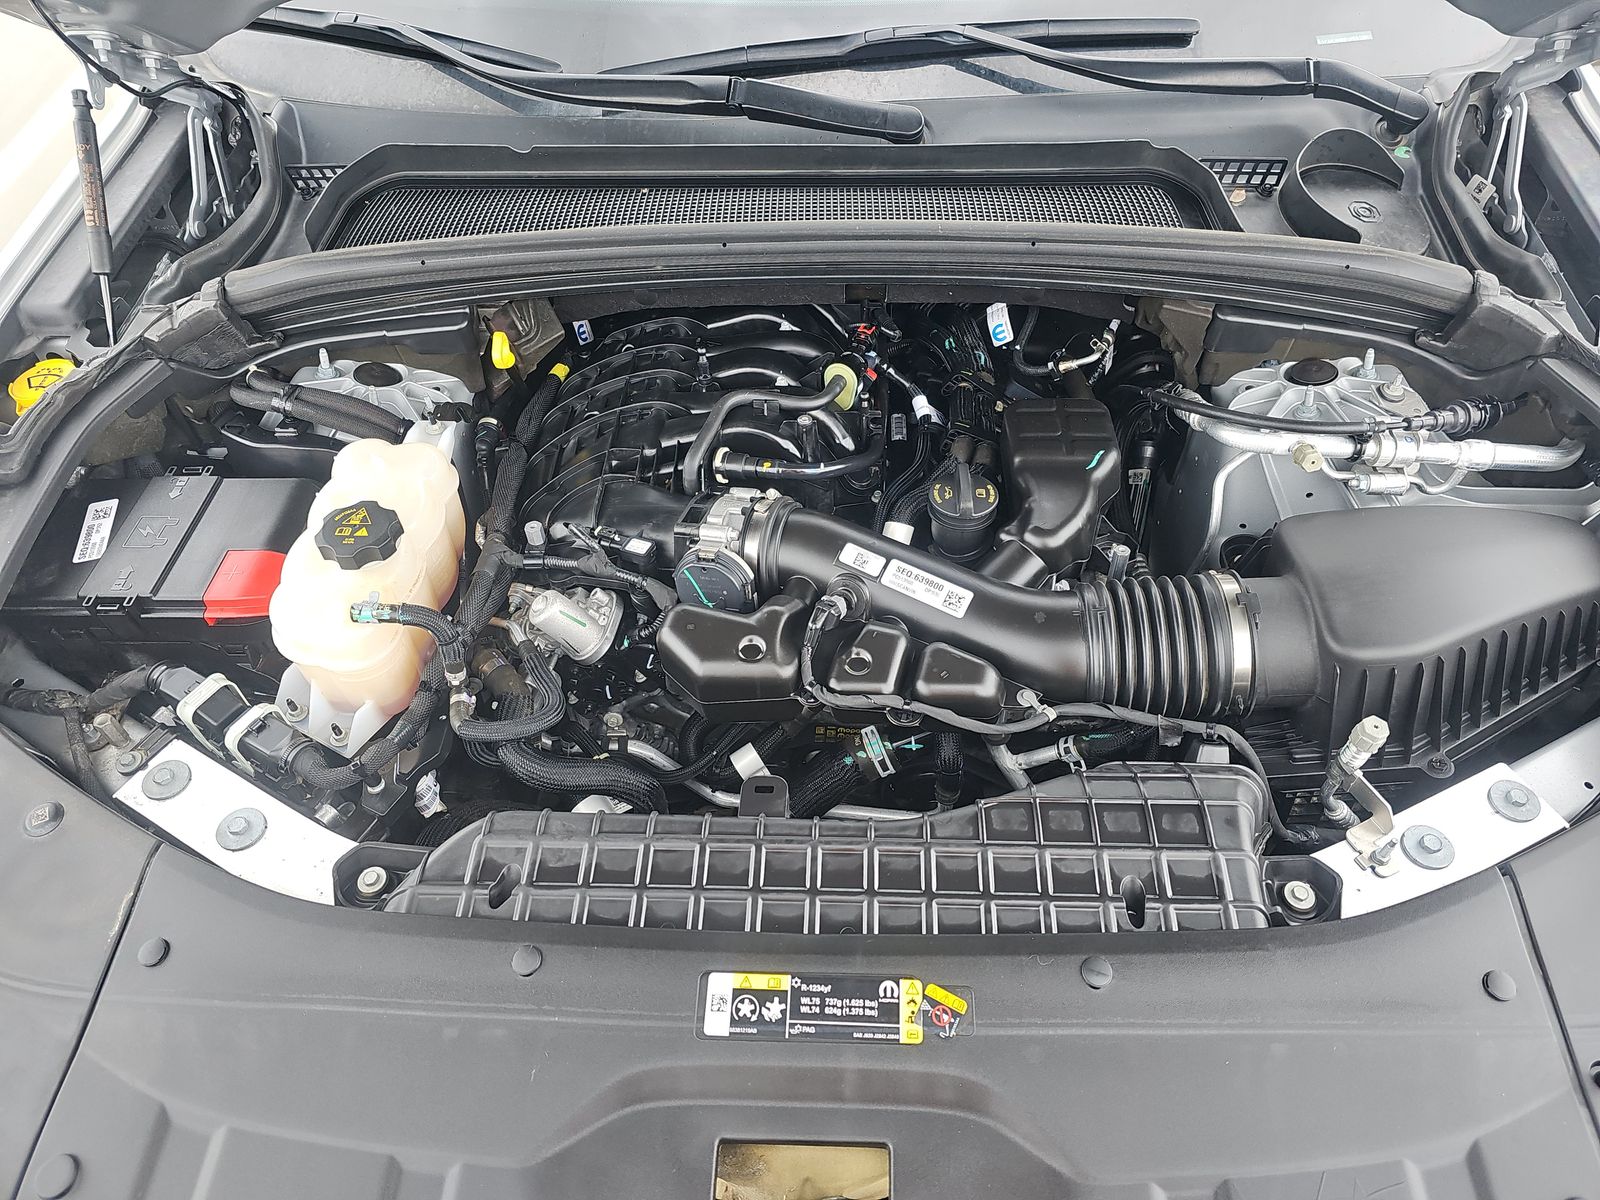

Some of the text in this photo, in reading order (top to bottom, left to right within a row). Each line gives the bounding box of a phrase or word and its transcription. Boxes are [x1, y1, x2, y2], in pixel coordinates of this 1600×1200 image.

[895, 565, 945, 592] SEQ:639800
[801, 983, 832, 993] R-1234yf
[800, 996, 878, 1008] WL75 737g (1.625 lbs)
[800, 1006, 878, 1017] WL74 624g (1.375 lbs)
